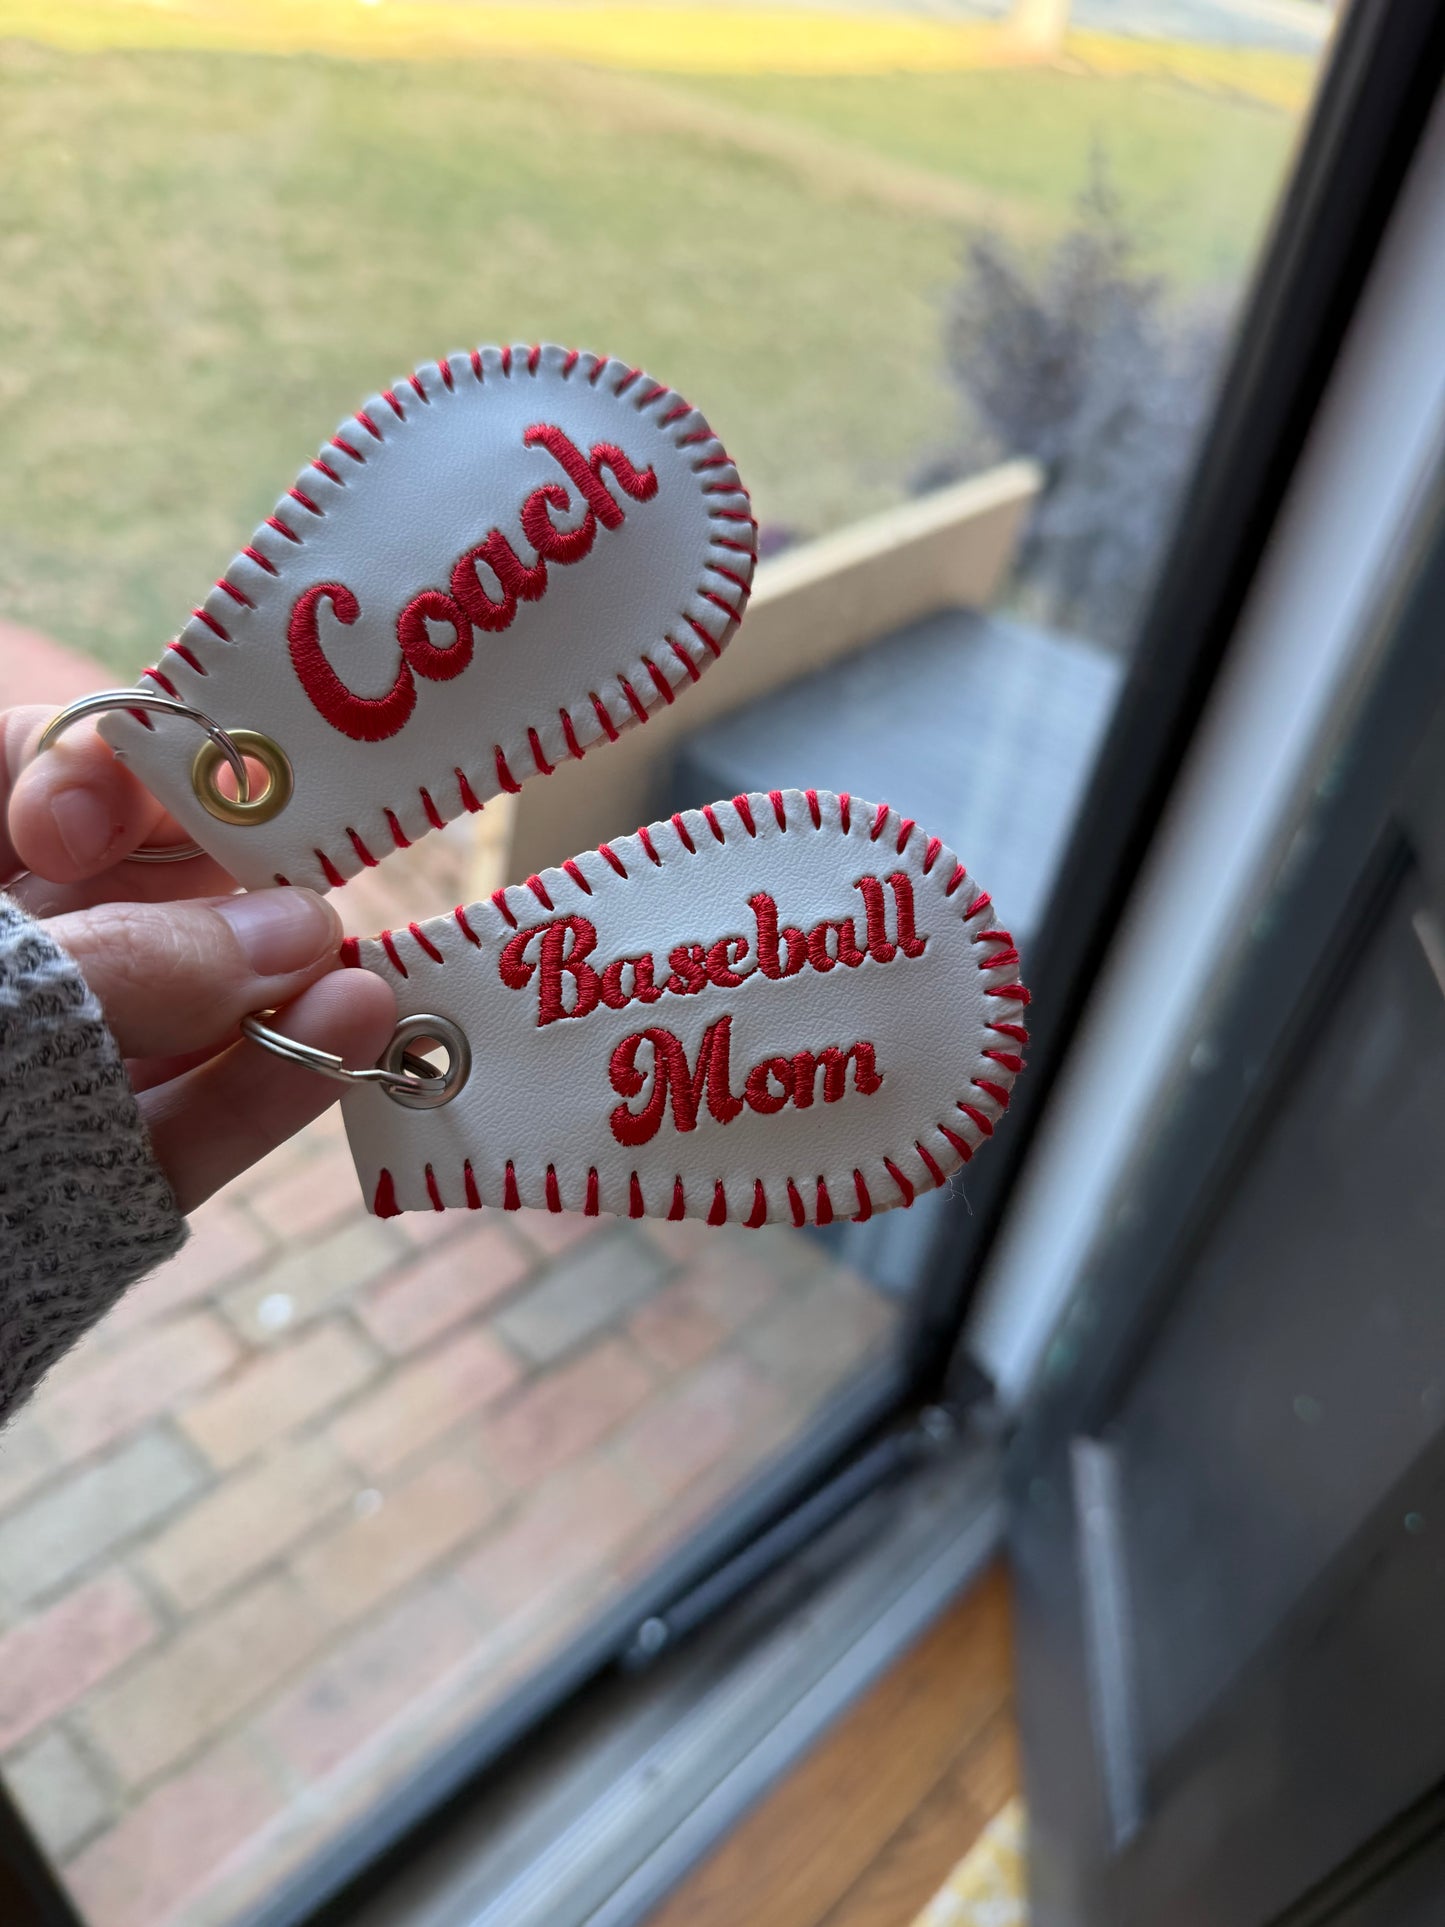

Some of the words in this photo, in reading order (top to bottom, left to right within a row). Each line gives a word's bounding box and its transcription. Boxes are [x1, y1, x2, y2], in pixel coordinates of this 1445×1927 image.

[289, 424, 658, 742] Coach
[499, 872, 927, 1027] Baseball
[609, 1016, 884, 1147] Mom
